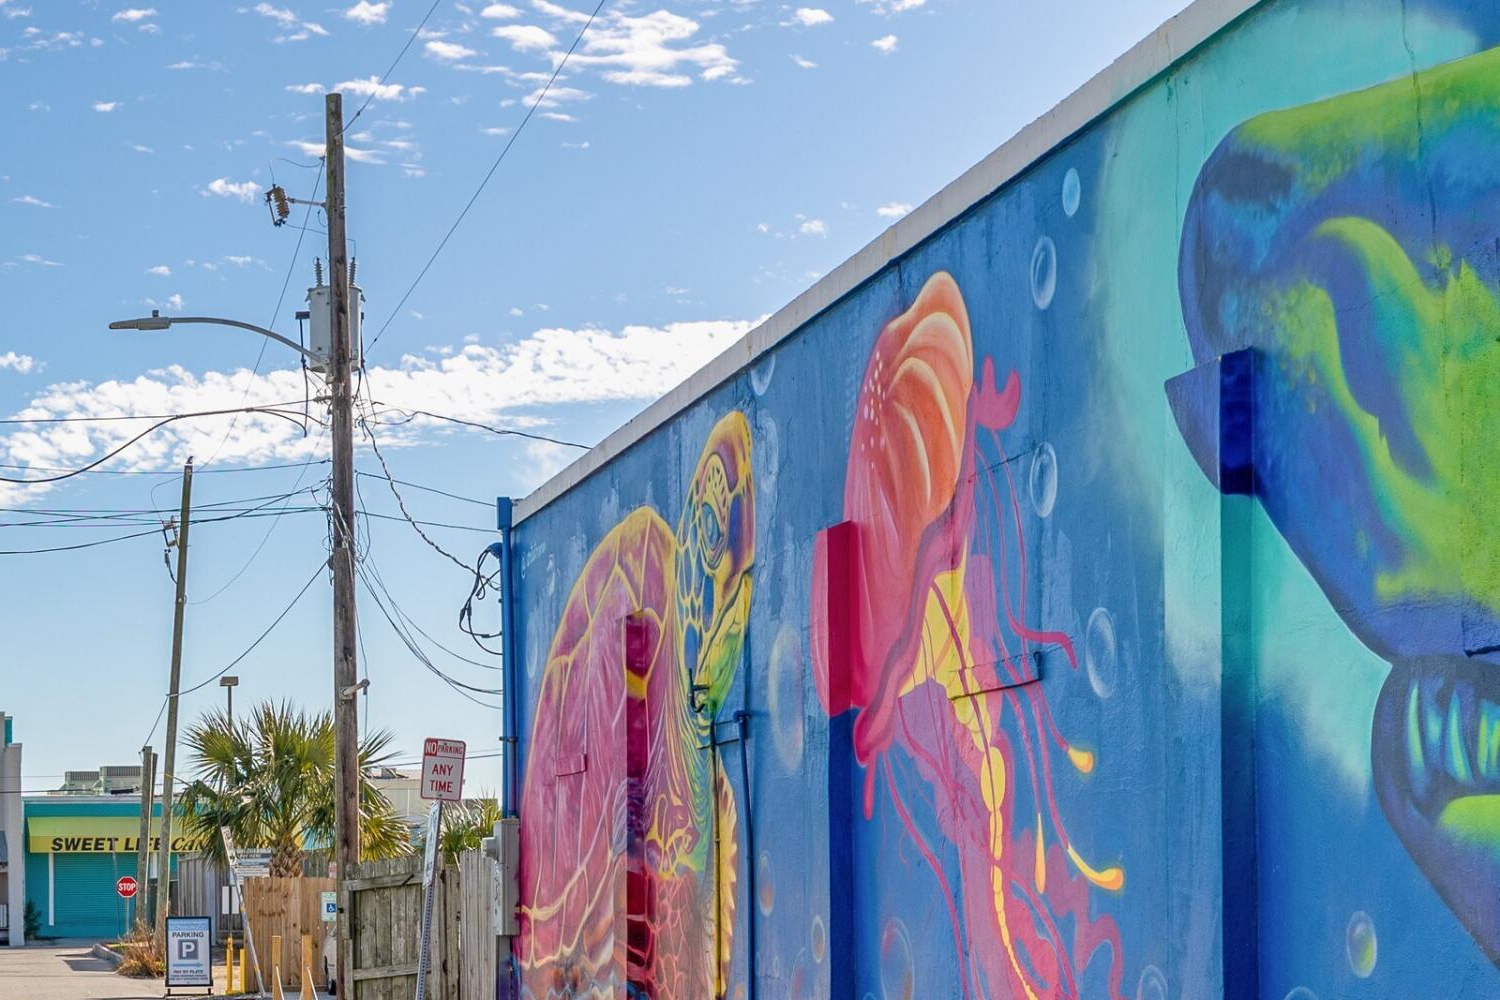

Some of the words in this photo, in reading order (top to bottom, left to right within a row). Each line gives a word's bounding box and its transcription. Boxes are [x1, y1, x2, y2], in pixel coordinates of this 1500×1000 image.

[425, 741, 437, 755] NO
[438, 744, 463, 755] PARKING
[432, 764, 453, 776] ANY
[430, 780, 453, 793] TIME
[51, 837, 119, 851] SWEET
[118, 882, 136, 891] STOP
[182, 941, 195, 958] P
